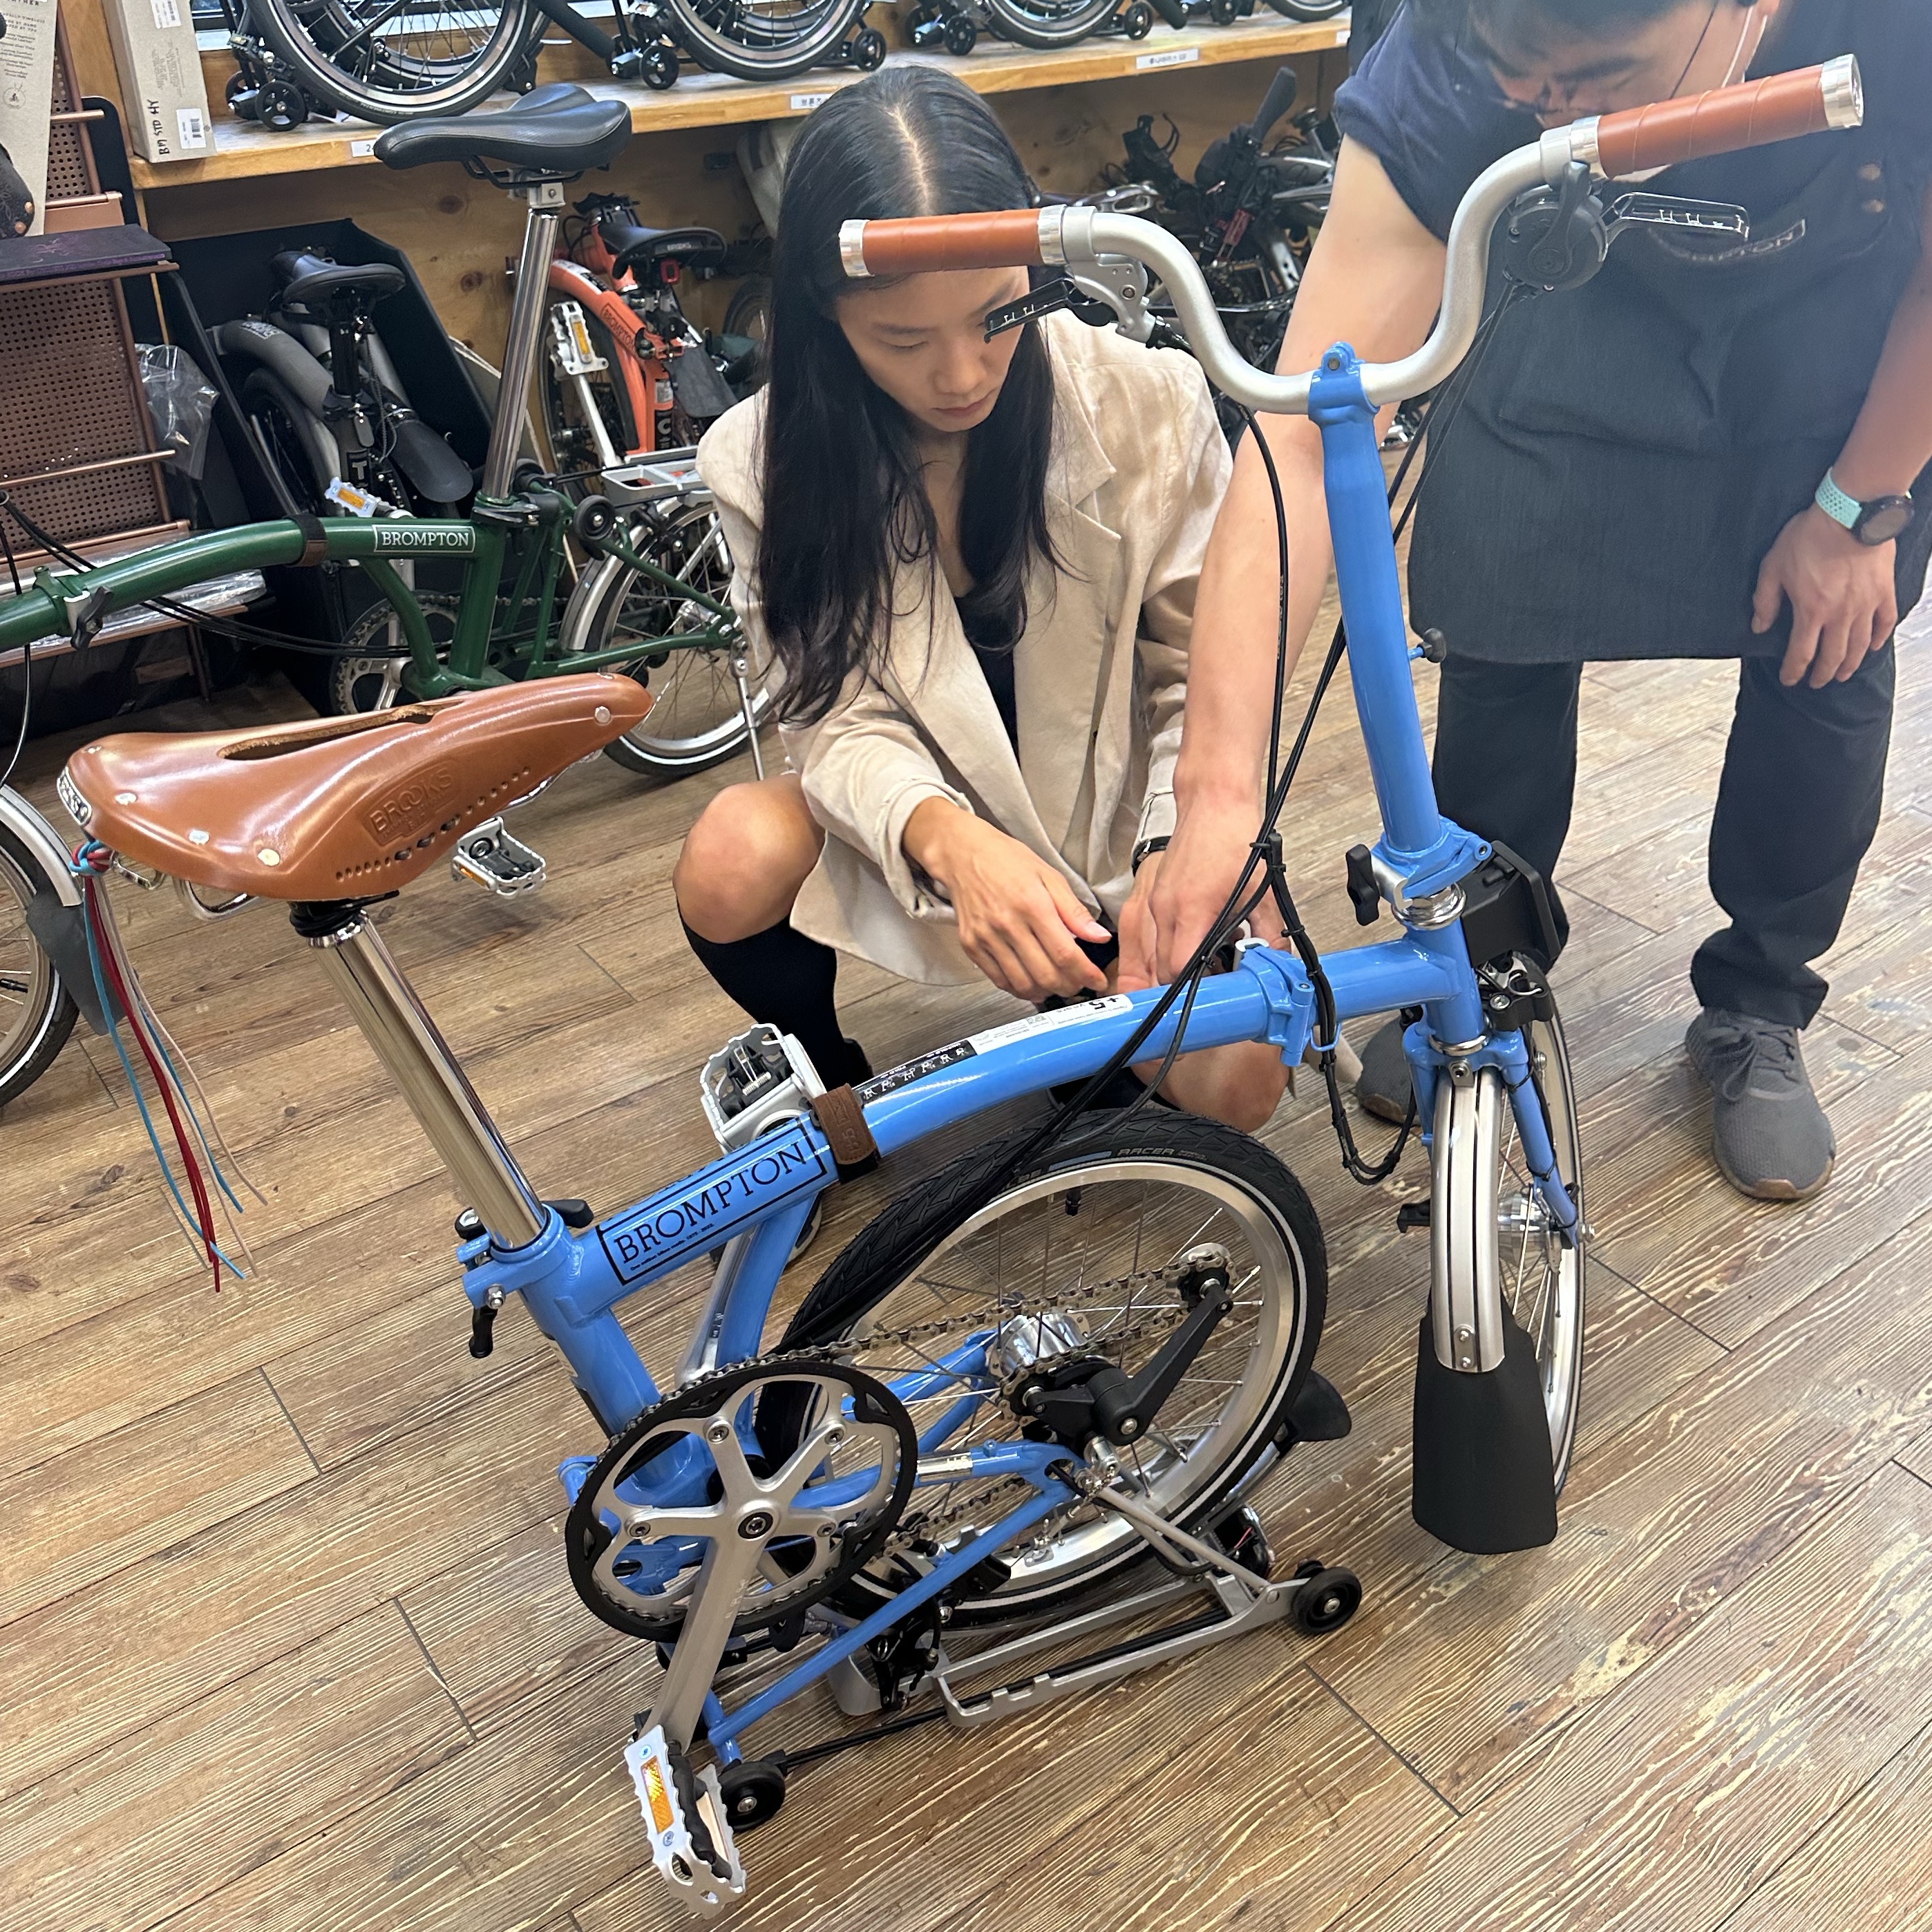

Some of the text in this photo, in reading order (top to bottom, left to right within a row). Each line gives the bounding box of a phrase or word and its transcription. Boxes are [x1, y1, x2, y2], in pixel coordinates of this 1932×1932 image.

[153, 120, 163, 137] STD
[381, 531, 469, 547] BROMPTON
[370, 767, 453, 833] BROOKS
[1088, 994, 1120, 1012] +5
[1117, 1147, 1175, 1157] RACER
[614, 1142, 807, 1265] BROMPTON
